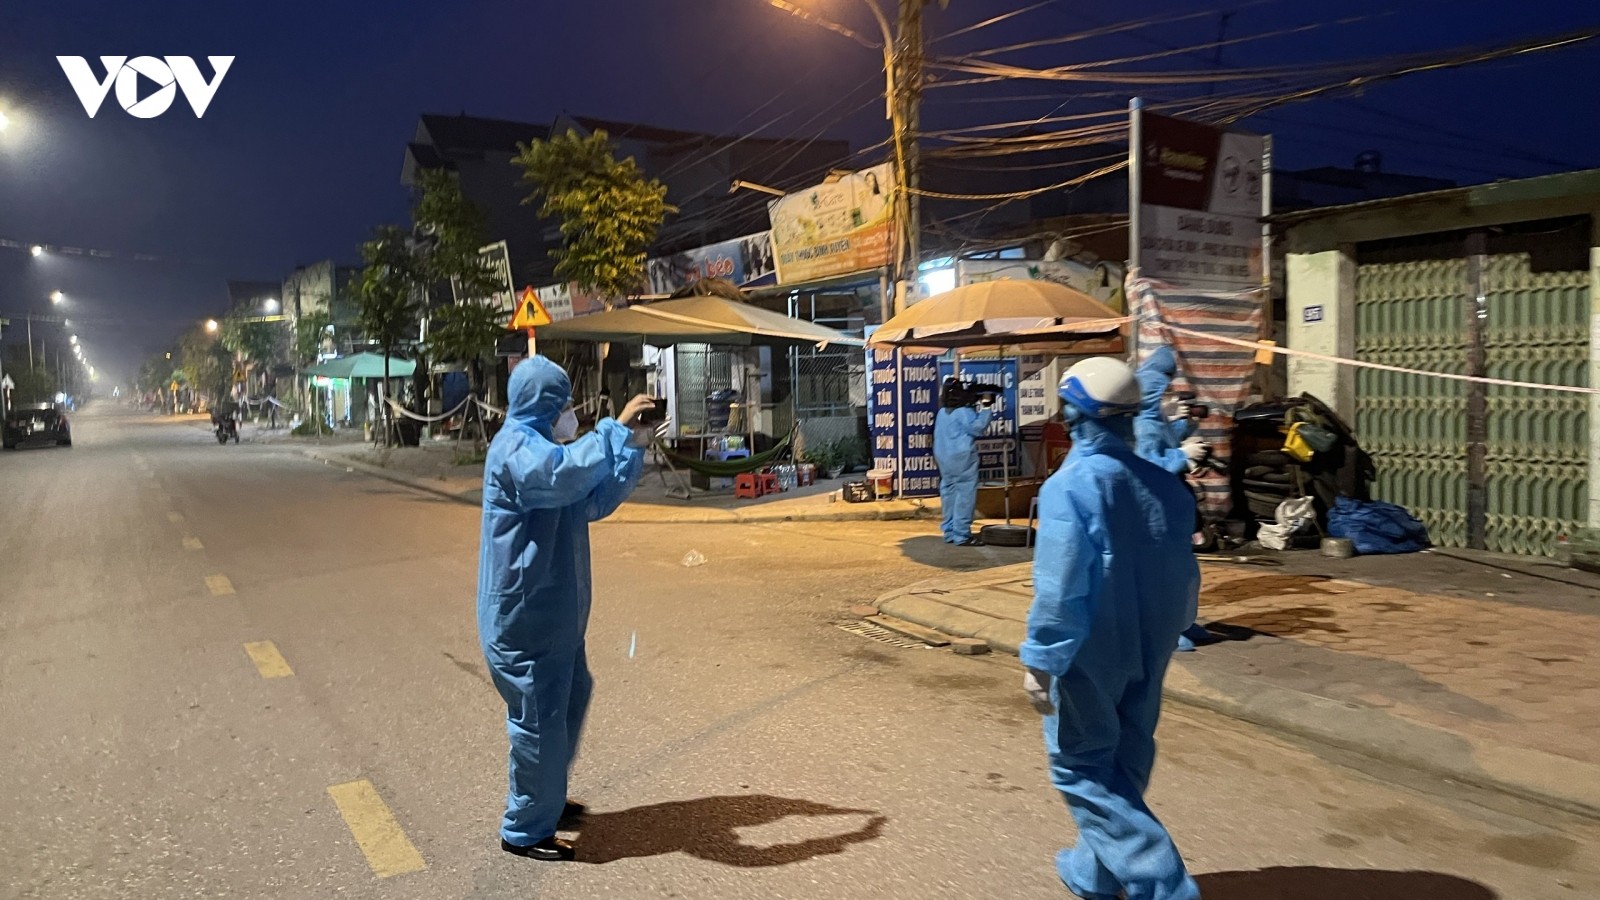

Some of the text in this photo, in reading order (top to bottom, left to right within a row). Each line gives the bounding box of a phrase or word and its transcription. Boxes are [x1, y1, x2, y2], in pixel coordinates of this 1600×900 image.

[873, 363, 897, 384] THUỐC
[903, 361, 937, 383] THUỐC
[877, 388, 893, 406] TÂN
[909, 388, 931, 404] TÂN
[906, 411, 934, 430] DƯỢC
